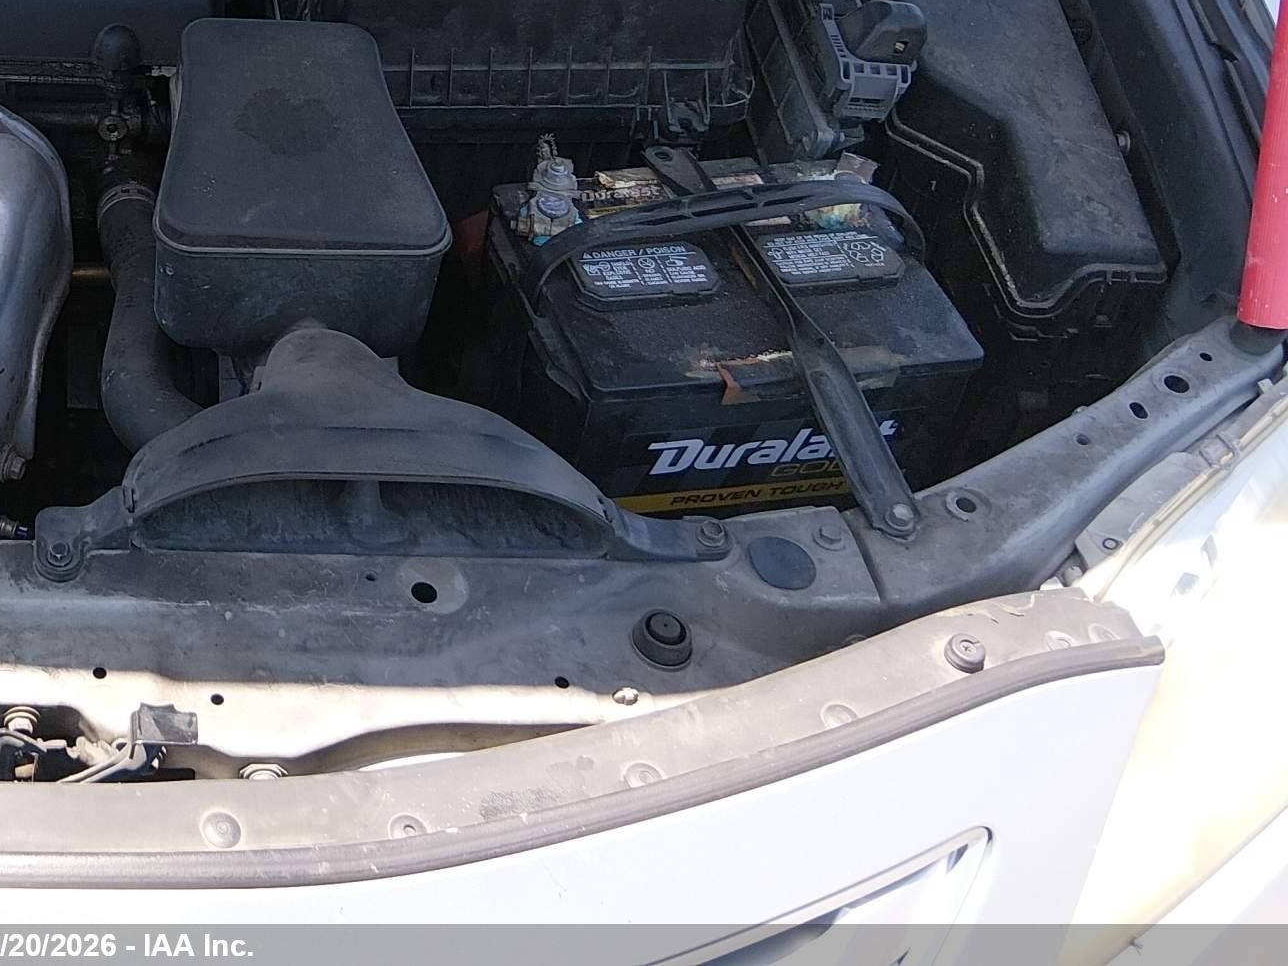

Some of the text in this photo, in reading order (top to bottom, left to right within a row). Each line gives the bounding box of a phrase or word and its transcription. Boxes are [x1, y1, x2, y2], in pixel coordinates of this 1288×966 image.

[592, 248, 637, 259] DANGER
[646, 245, 687, 255] POISON
[648, 419, 898, 475] Durala
[771, 459, 842, 477] GOL
[670, 480, 847, 507] PROVEN TOUGH
